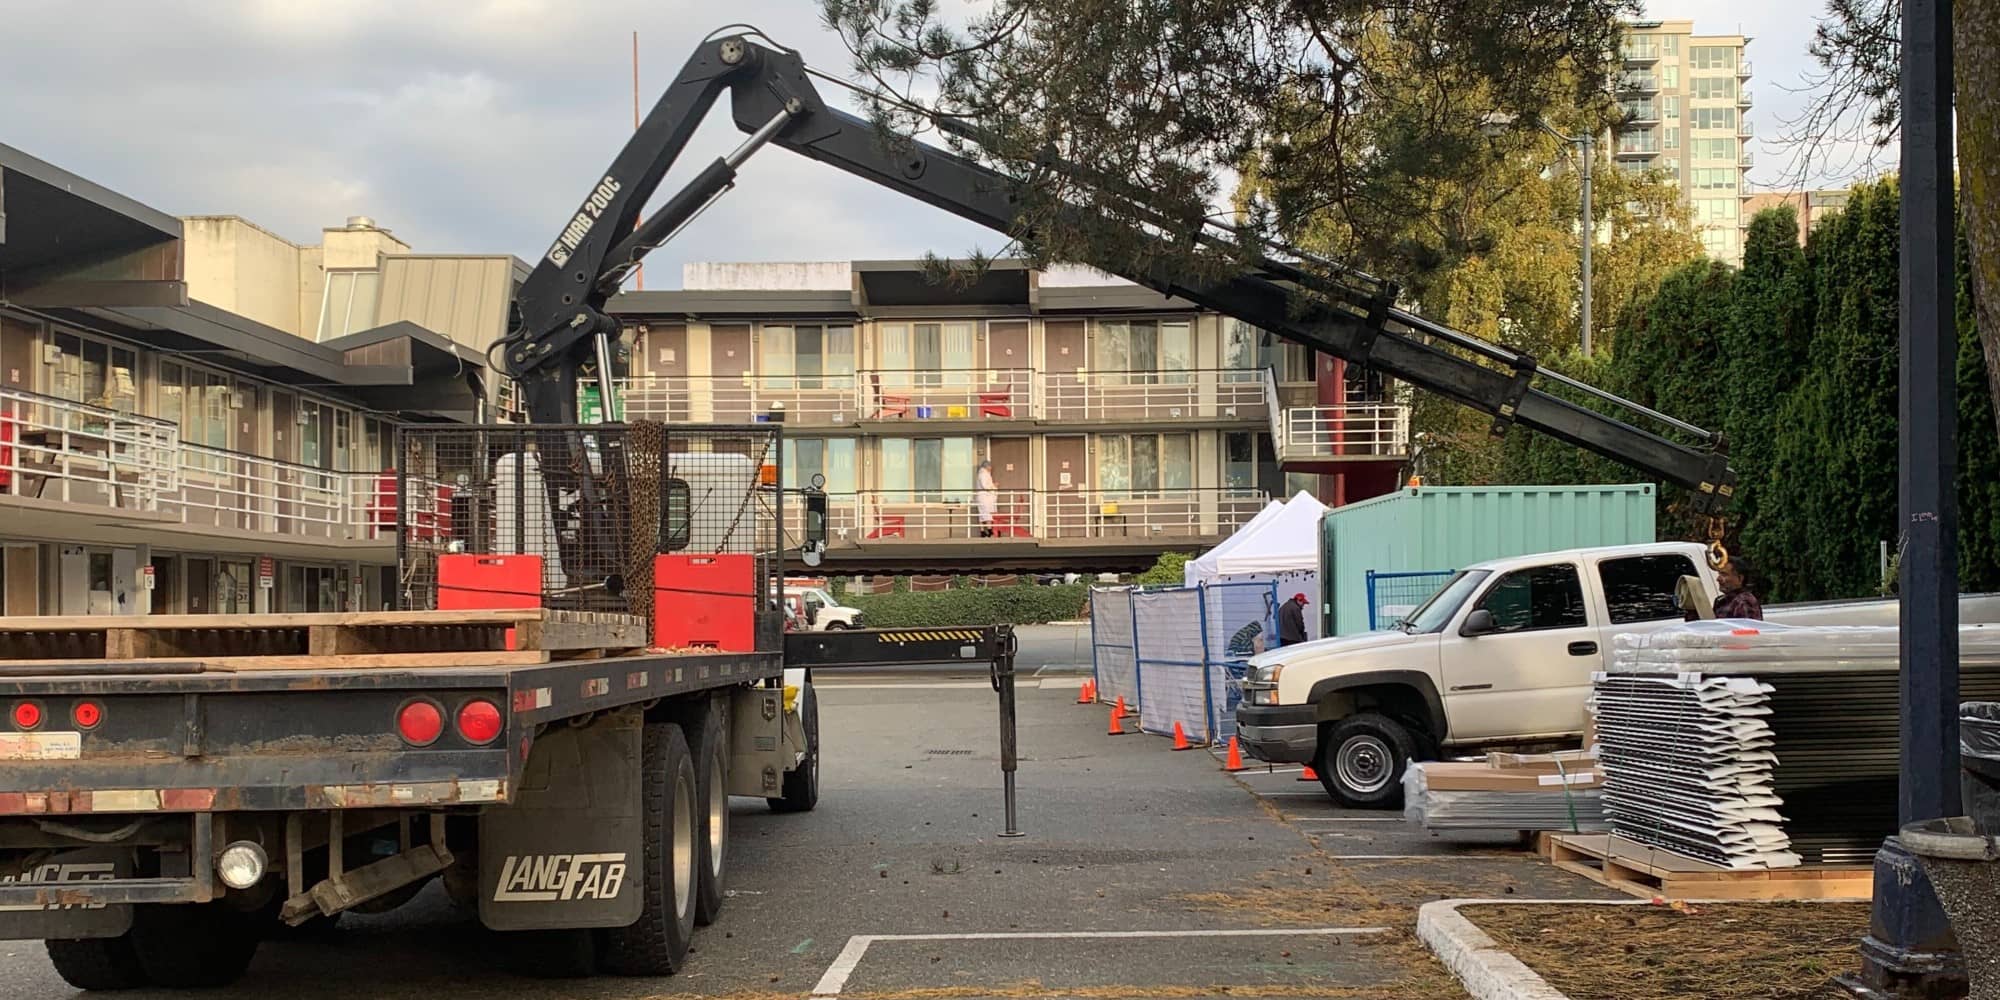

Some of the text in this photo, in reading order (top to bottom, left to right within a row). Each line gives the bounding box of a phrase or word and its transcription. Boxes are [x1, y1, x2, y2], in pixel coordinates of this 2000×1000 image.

[560, 175, 621, 250] HIAB 200C
[494, 852, 626, 901] LANGFAB
